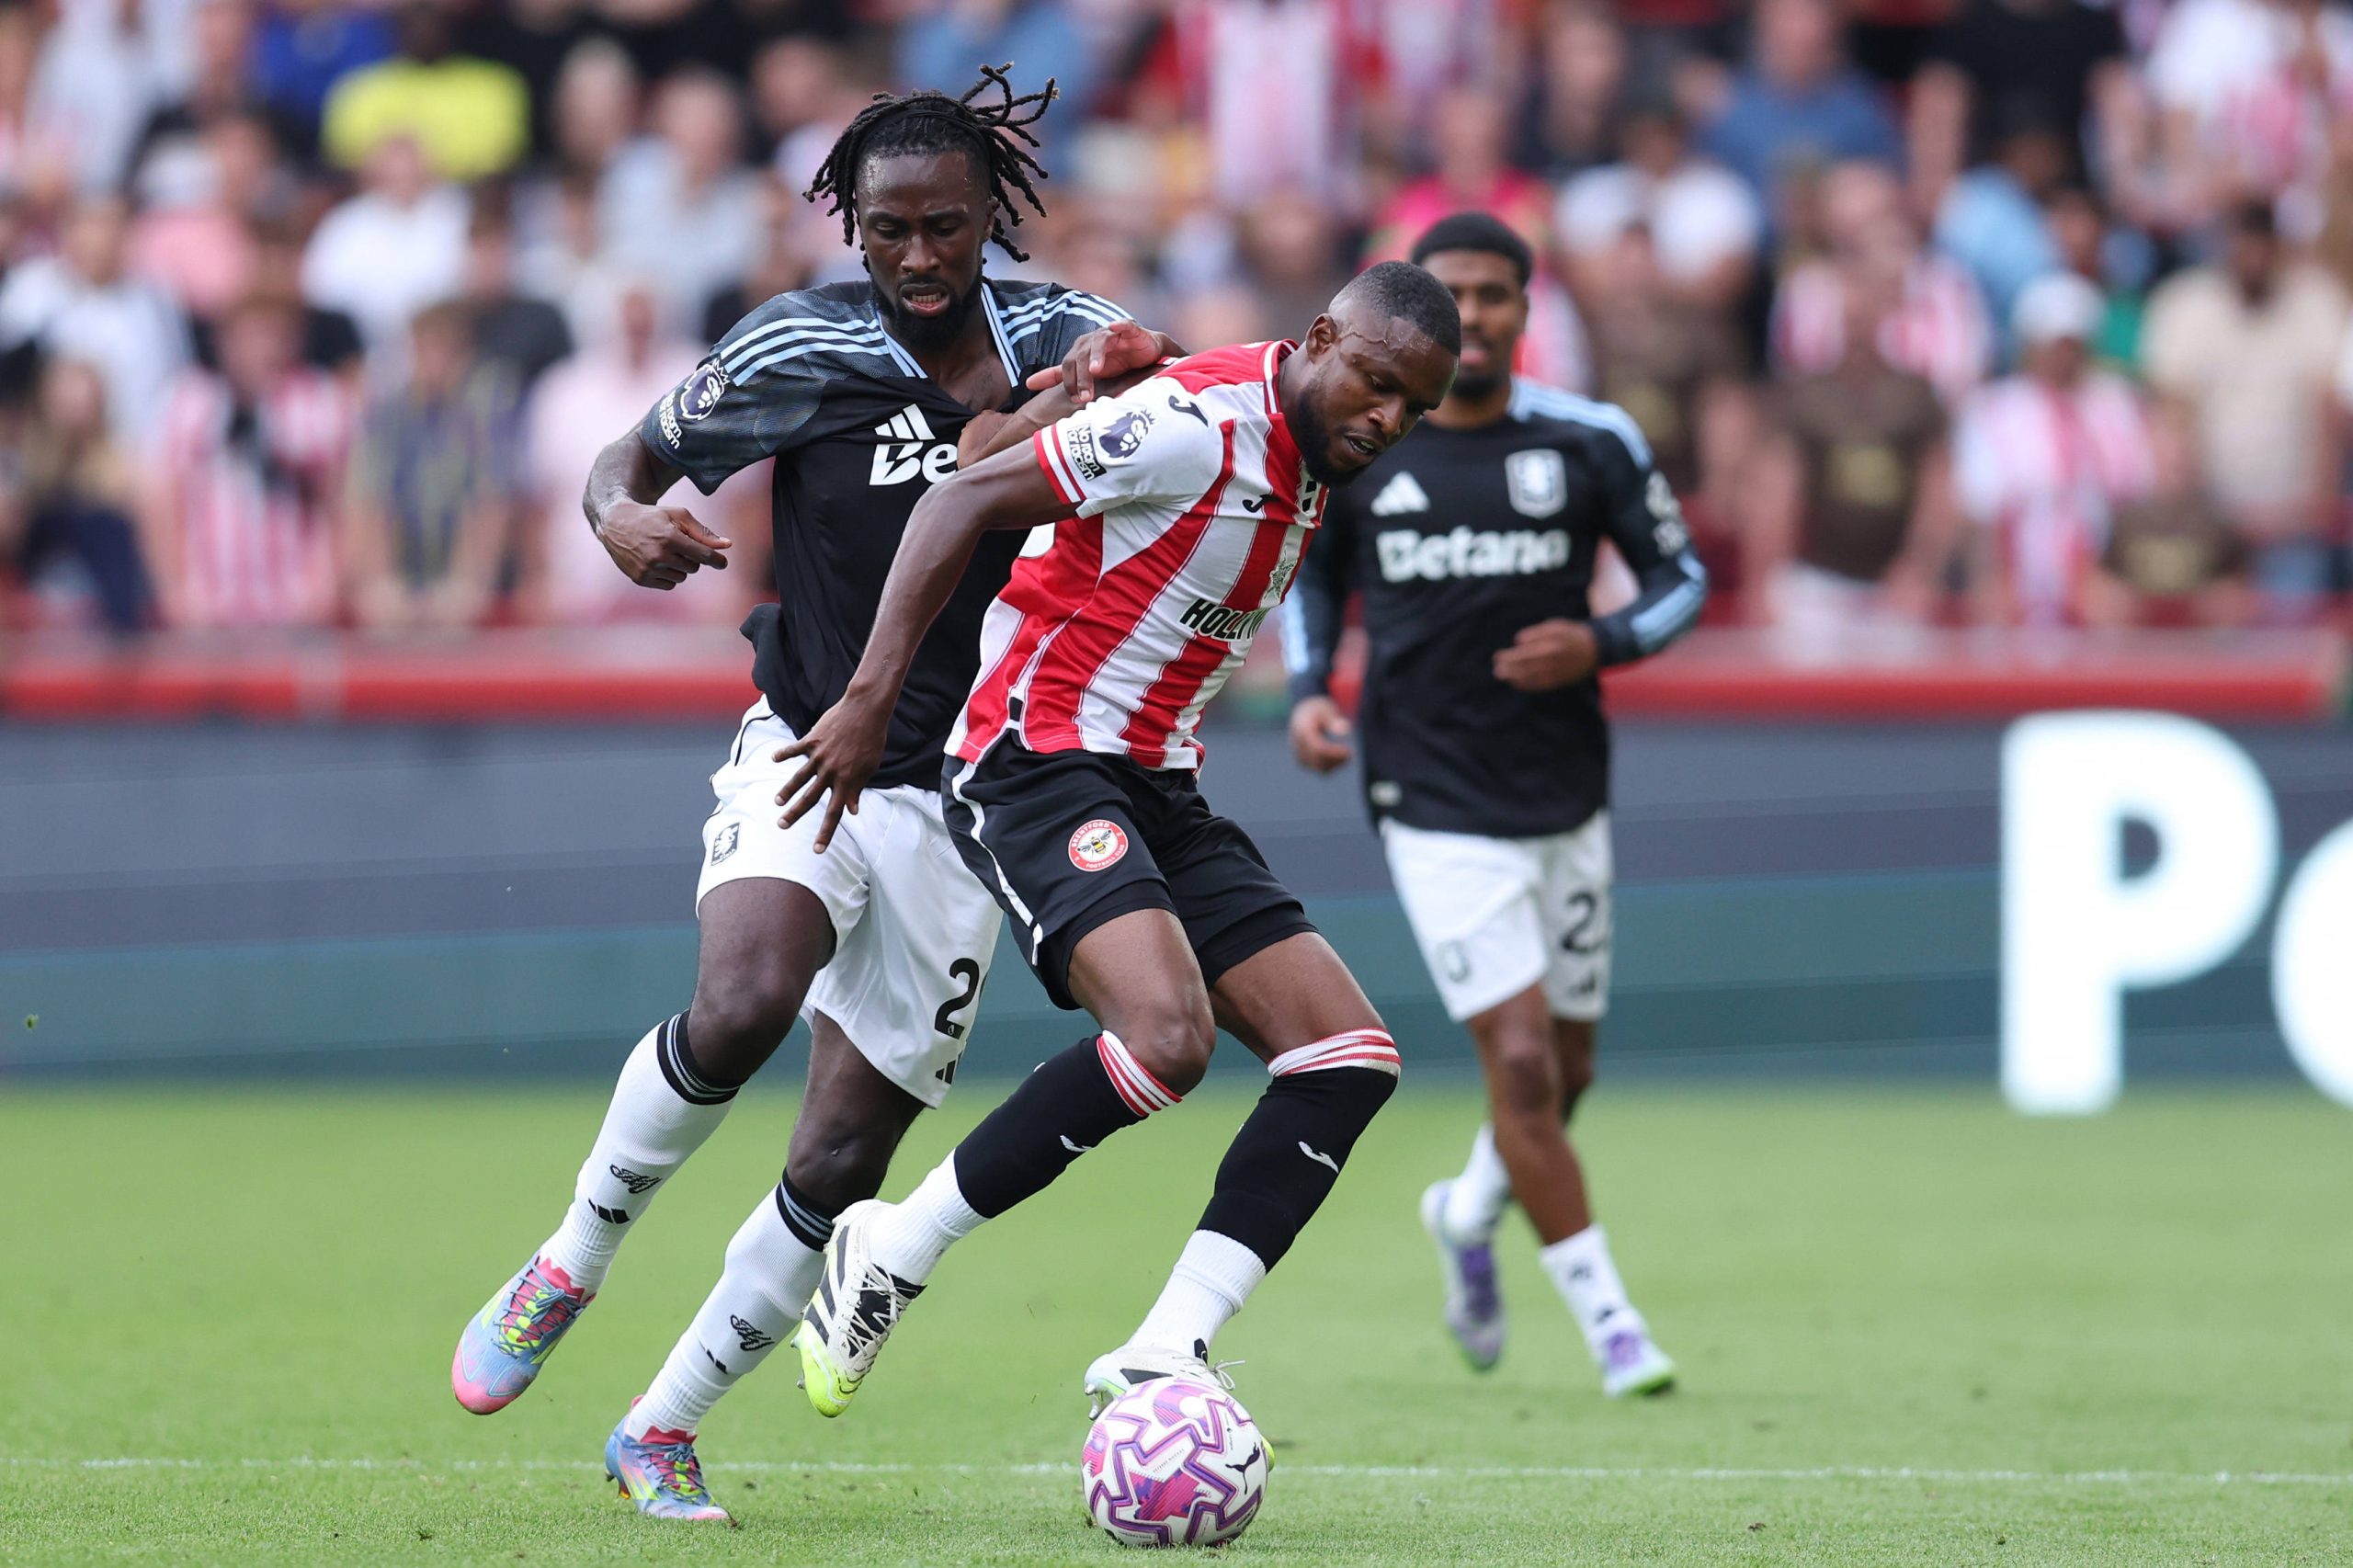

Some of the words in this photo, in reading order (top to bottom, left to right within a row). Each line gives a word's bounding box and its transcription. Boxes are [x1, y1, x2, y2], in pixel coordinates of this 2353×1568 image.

[1077, 426, 1091, 442] No
[870, 441, 958, 486] Be
[1070, 442, 1095, 481] racism
[1081, 442, 1102, 472] room
[1376, 525, 1572, 584] Betano
[1071, 822, 1110, 847] BRENTFORD
[1086, 857, 1116, 869] FOOTBALL
[1999, 707, 2353, 1119] P
[934, 958, 988, 1040] 2
